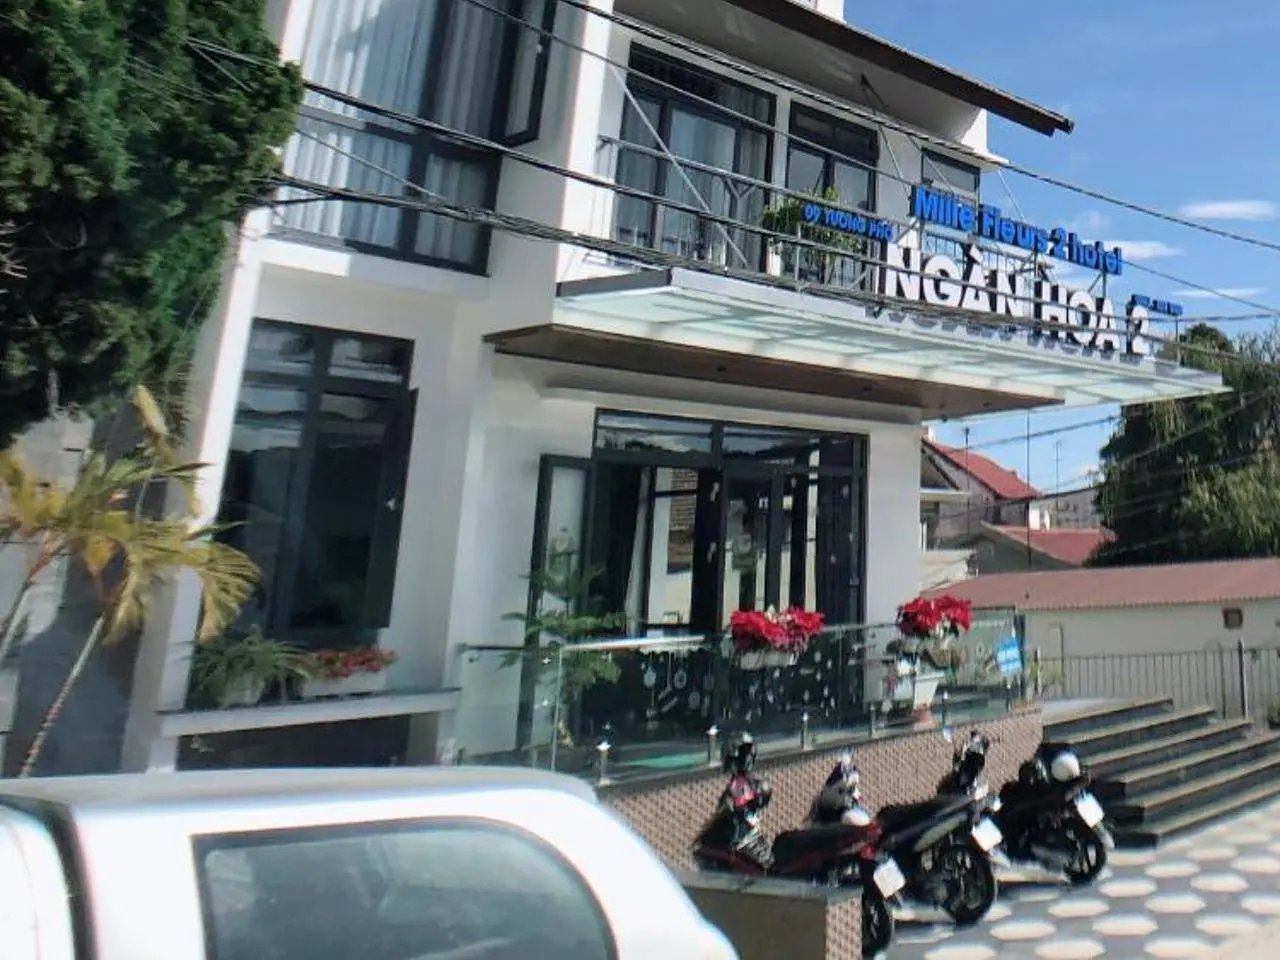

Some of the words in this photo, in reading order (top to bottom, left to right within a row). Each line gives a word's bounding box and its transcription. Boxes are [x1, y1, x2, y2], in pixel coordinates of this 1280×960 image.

[914, 184, 976, 231] Mille
[981, 205, 1048, 253] Fleurs
[1053, 227, 1068, 260] 2
[1070, 234, 1123, 275] hotel
[1041, 280, 1120, 351] HOA
[1131, 304, 1150, 355] 2
